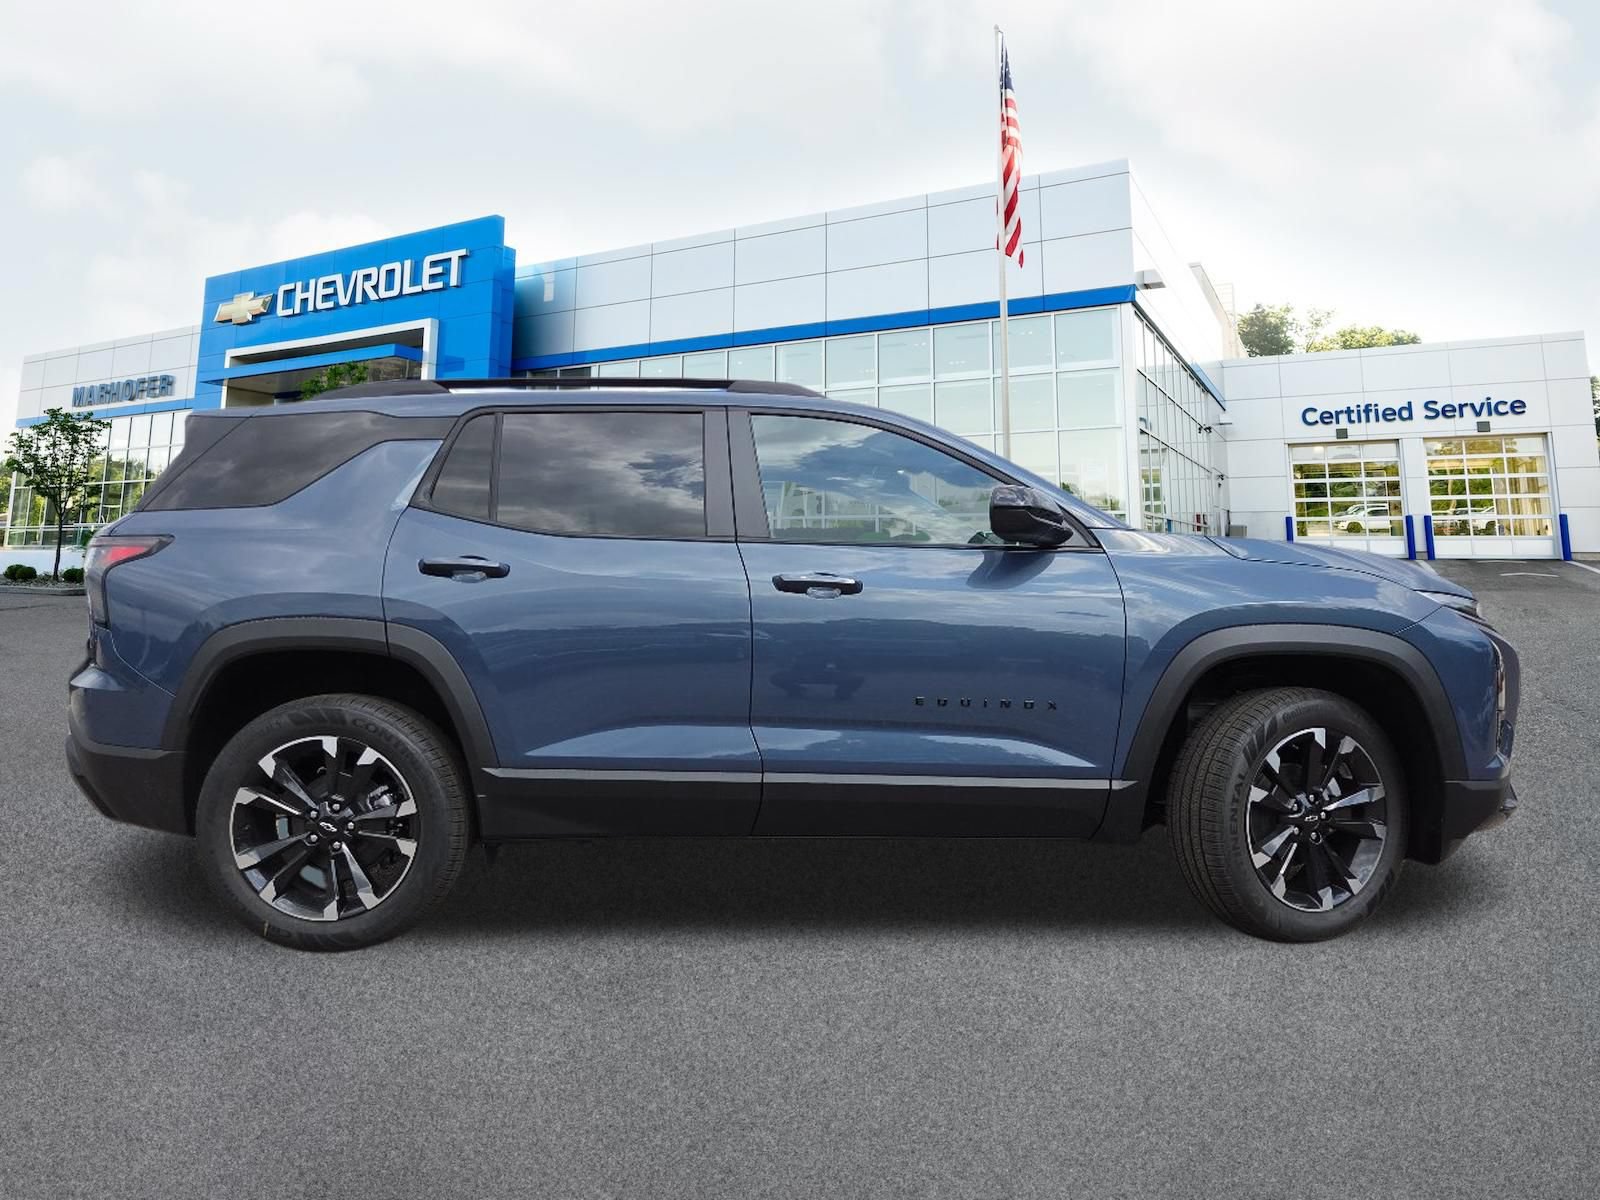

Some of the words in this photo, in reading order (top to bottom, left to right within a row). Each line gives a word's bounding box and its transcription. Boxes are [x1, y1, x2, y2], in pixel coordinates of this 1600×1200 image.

[276, 248, 470, 318] CHEVROLET
[72, 374, 175, 408] MARHOFER
[1301, 401, 1414, 426] Certified
[1423, 396, 1528, 420] Service
[914, 696, 1058, 711] EQUINOX
